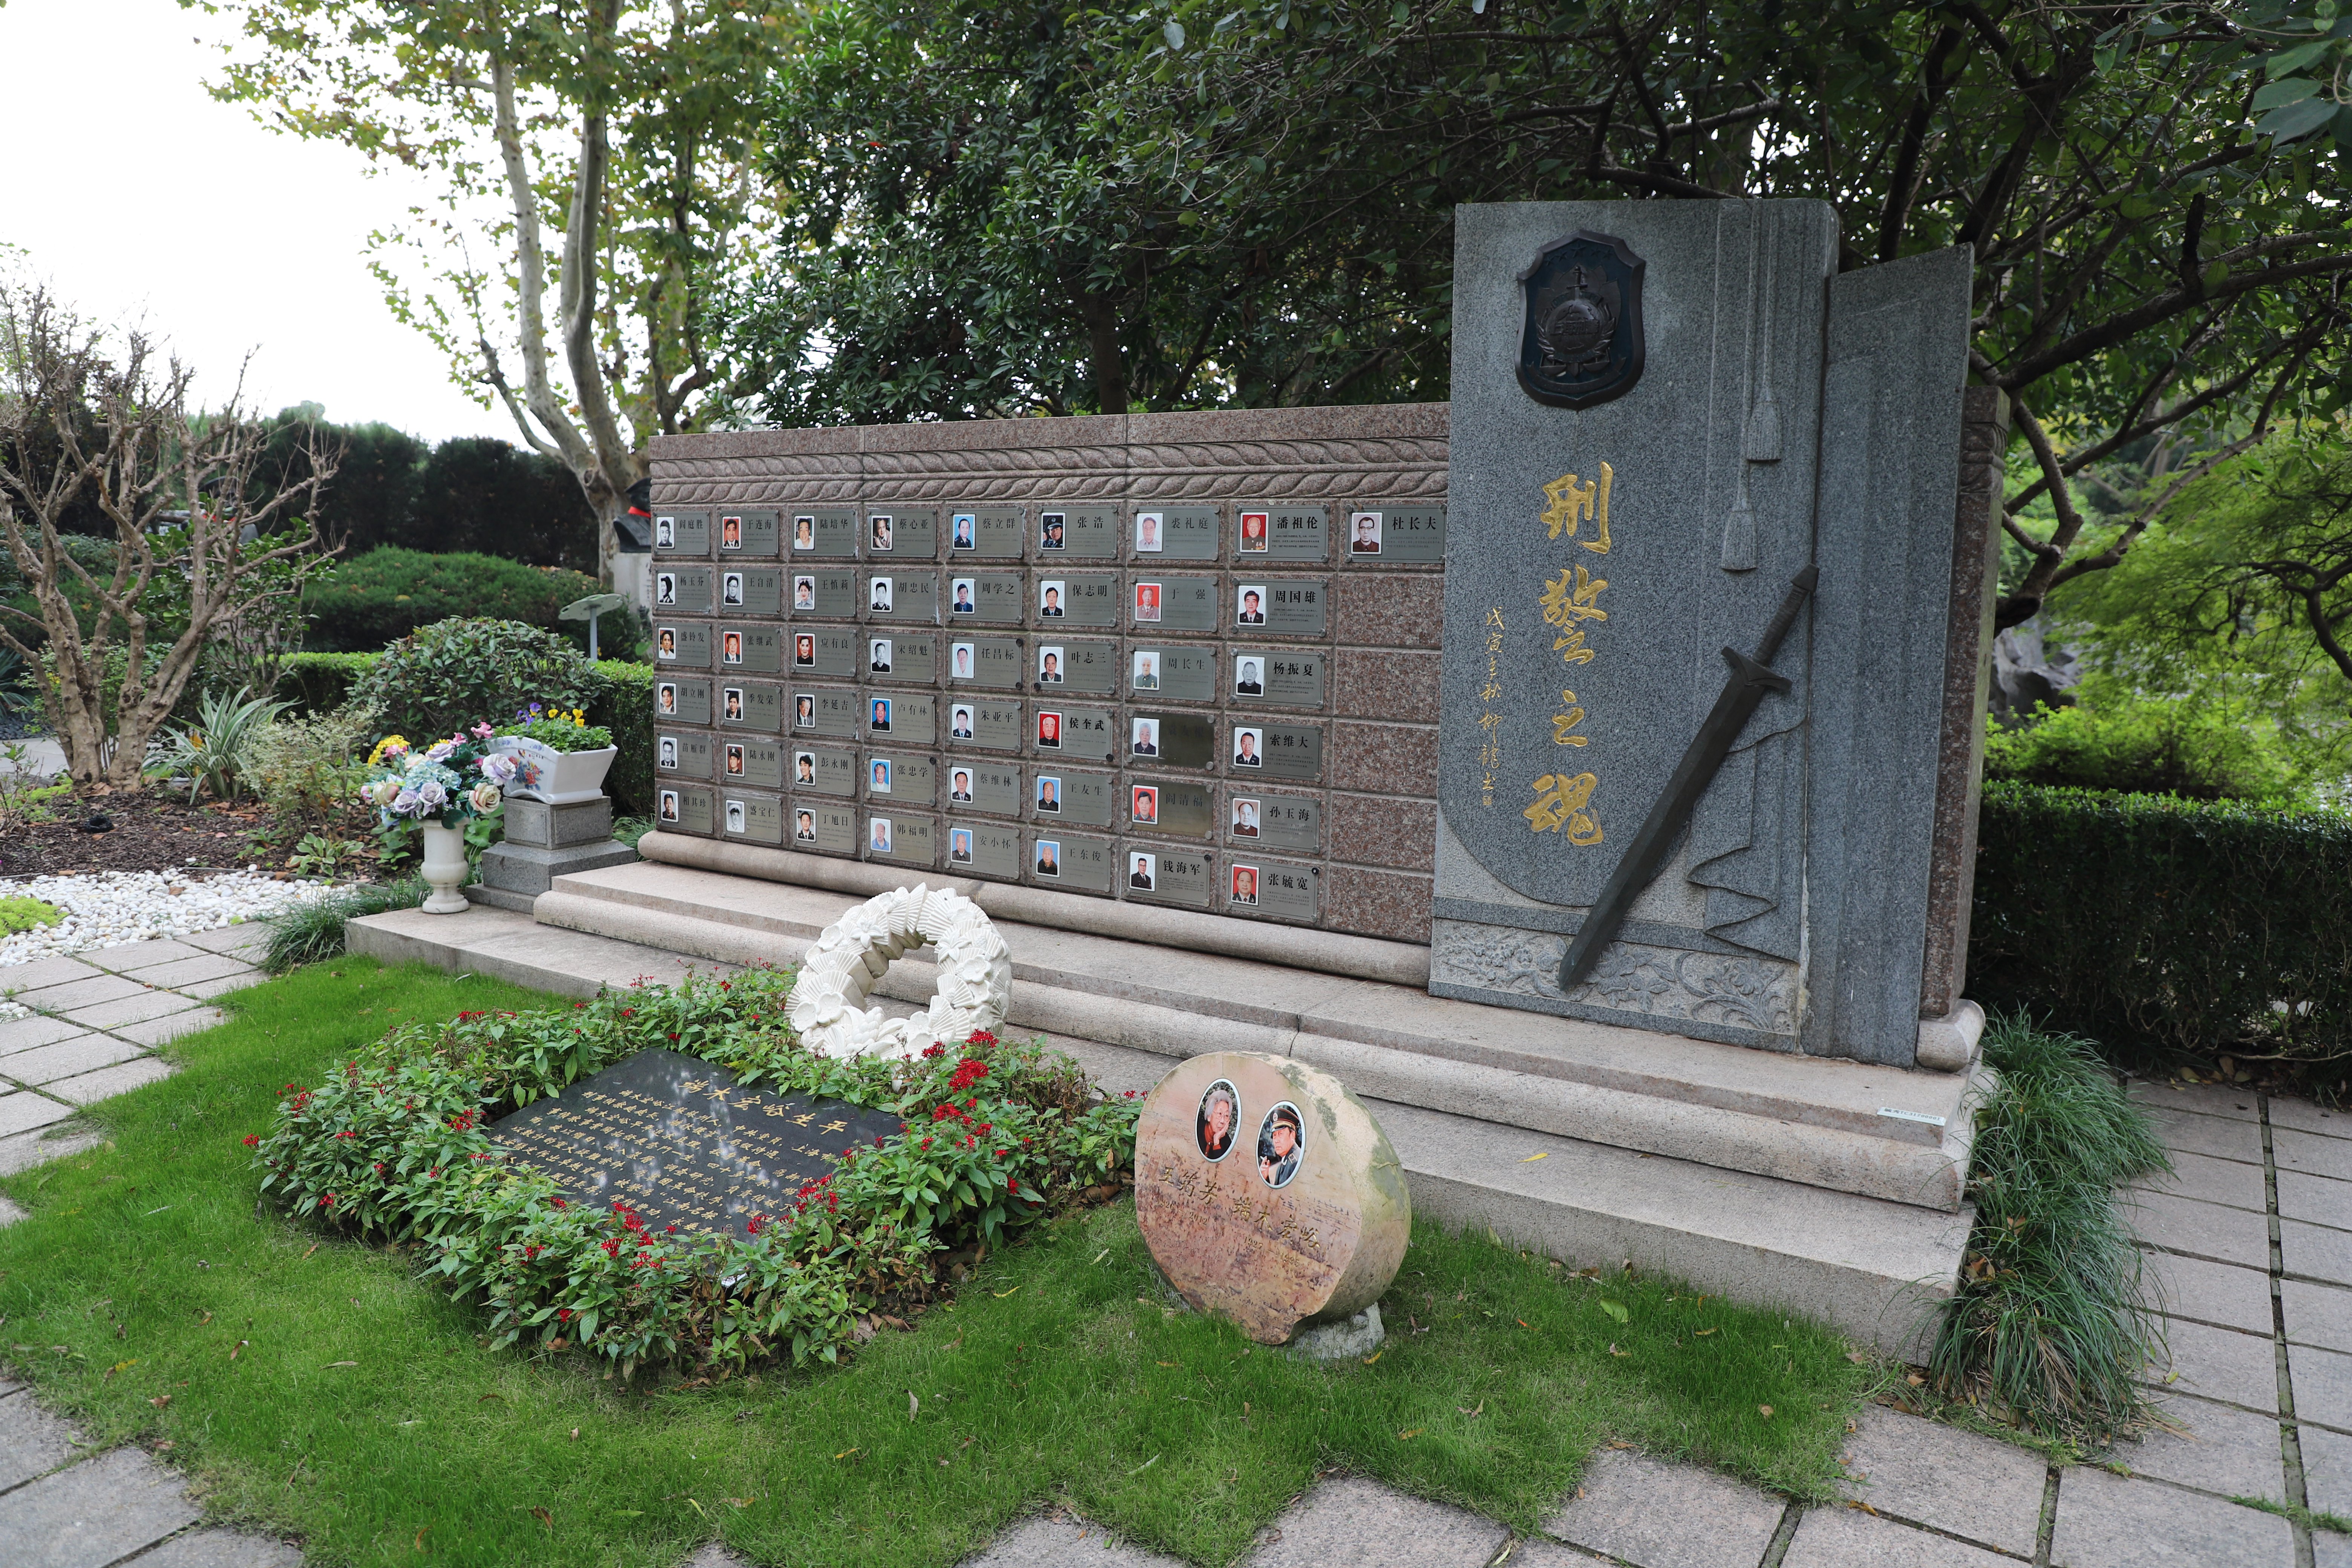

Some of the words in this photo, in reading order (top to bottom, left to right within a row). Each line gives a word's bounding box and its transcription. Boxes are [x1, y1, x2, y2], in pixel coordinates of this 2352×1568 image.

[747, 519, 772, 530] 于连海
[820, 518, 848, 530] 陆培华
[899, 518, 928, 530] 蔡心亚
[982, 518, 1015, 529] 蔡立群
[1077, 516, 1104, 528] 张浩
[1171, 517, 1209, 529] 裘礼庭
[1277, 516, 1318, 529] 潘祖伦
[1392, 516, 1436, 531] 杜长夫
[680, 576, 704, 586] 杨玉芬
[821, 579, 848, 590] 王慎莉
[899, 582, 929, 594] 胡忠民
[982, 583, 1015, 594] 周学之
[1072, 584, 1107, 597] 保志明
[1170, 588, 1206, 600] 于强
[1275, 590, 1316, 604] 周国雄
[680, 631, 704, 642] 盛铃发
[747, 635, 772, 647] 张继武
[821, 637, 848, 649] 应有良
[897, 644, 928, 656] 宋绍魁
[981, 648, 1014, 660] 任昌标
[1523, 461, 1614, 847] 刑警之魂
[1071, 651, 1106, 664] 叶志三
[1168, 658, 1205, 671] 周长生
[1274, 662, 1314, 677] 杨振夏
[681, 686, 704, 698] 胡立刚
[748, 693, 773, 705] 季发荣
[821, 698, 848, 711] 李延吉
[898, 704, 927, 716] 卢有林
[980, 709, 1014, 723] 朱亚平
[1069, 717, 1104, 731] 侯奎武
[1269, 734, 1308, 748] 索维大
[749, 749, 775, 762] 陆永刚
[821, 756, 848, 770] 彭永刚
[897, 764, 928, 778] 张忠学
[980, 773, 1012, 787] 蔡维林
[1069, 783, 1103, 796] 王友生
[683, 796, 706, 807] 相其珍
[750, 805, 775, 818] 盛宝仁
[1269, 805, 1310, 821] 孙玉海
[822, 814, 848, 827] 丁旭日
[897, 824, 928, 838] 韩福明
[979, 836, 1011, 850] 安小怀
[1068, 848, 1101, 862] 王东俊
[1163, 860, 1201, 876] 钱海军
[1268, 873, 1308, 890] 张毓宽
[678, 1079, 848, 1135] 端木宏峪生平
[1189, 1212, 1207, 1225] 2012
[1233, 1196, 1321, 1249] 端木宏峪
[1244, 1236, 1263, 1250] 1927
[1280, 1251, 1300, 1267] 1995
